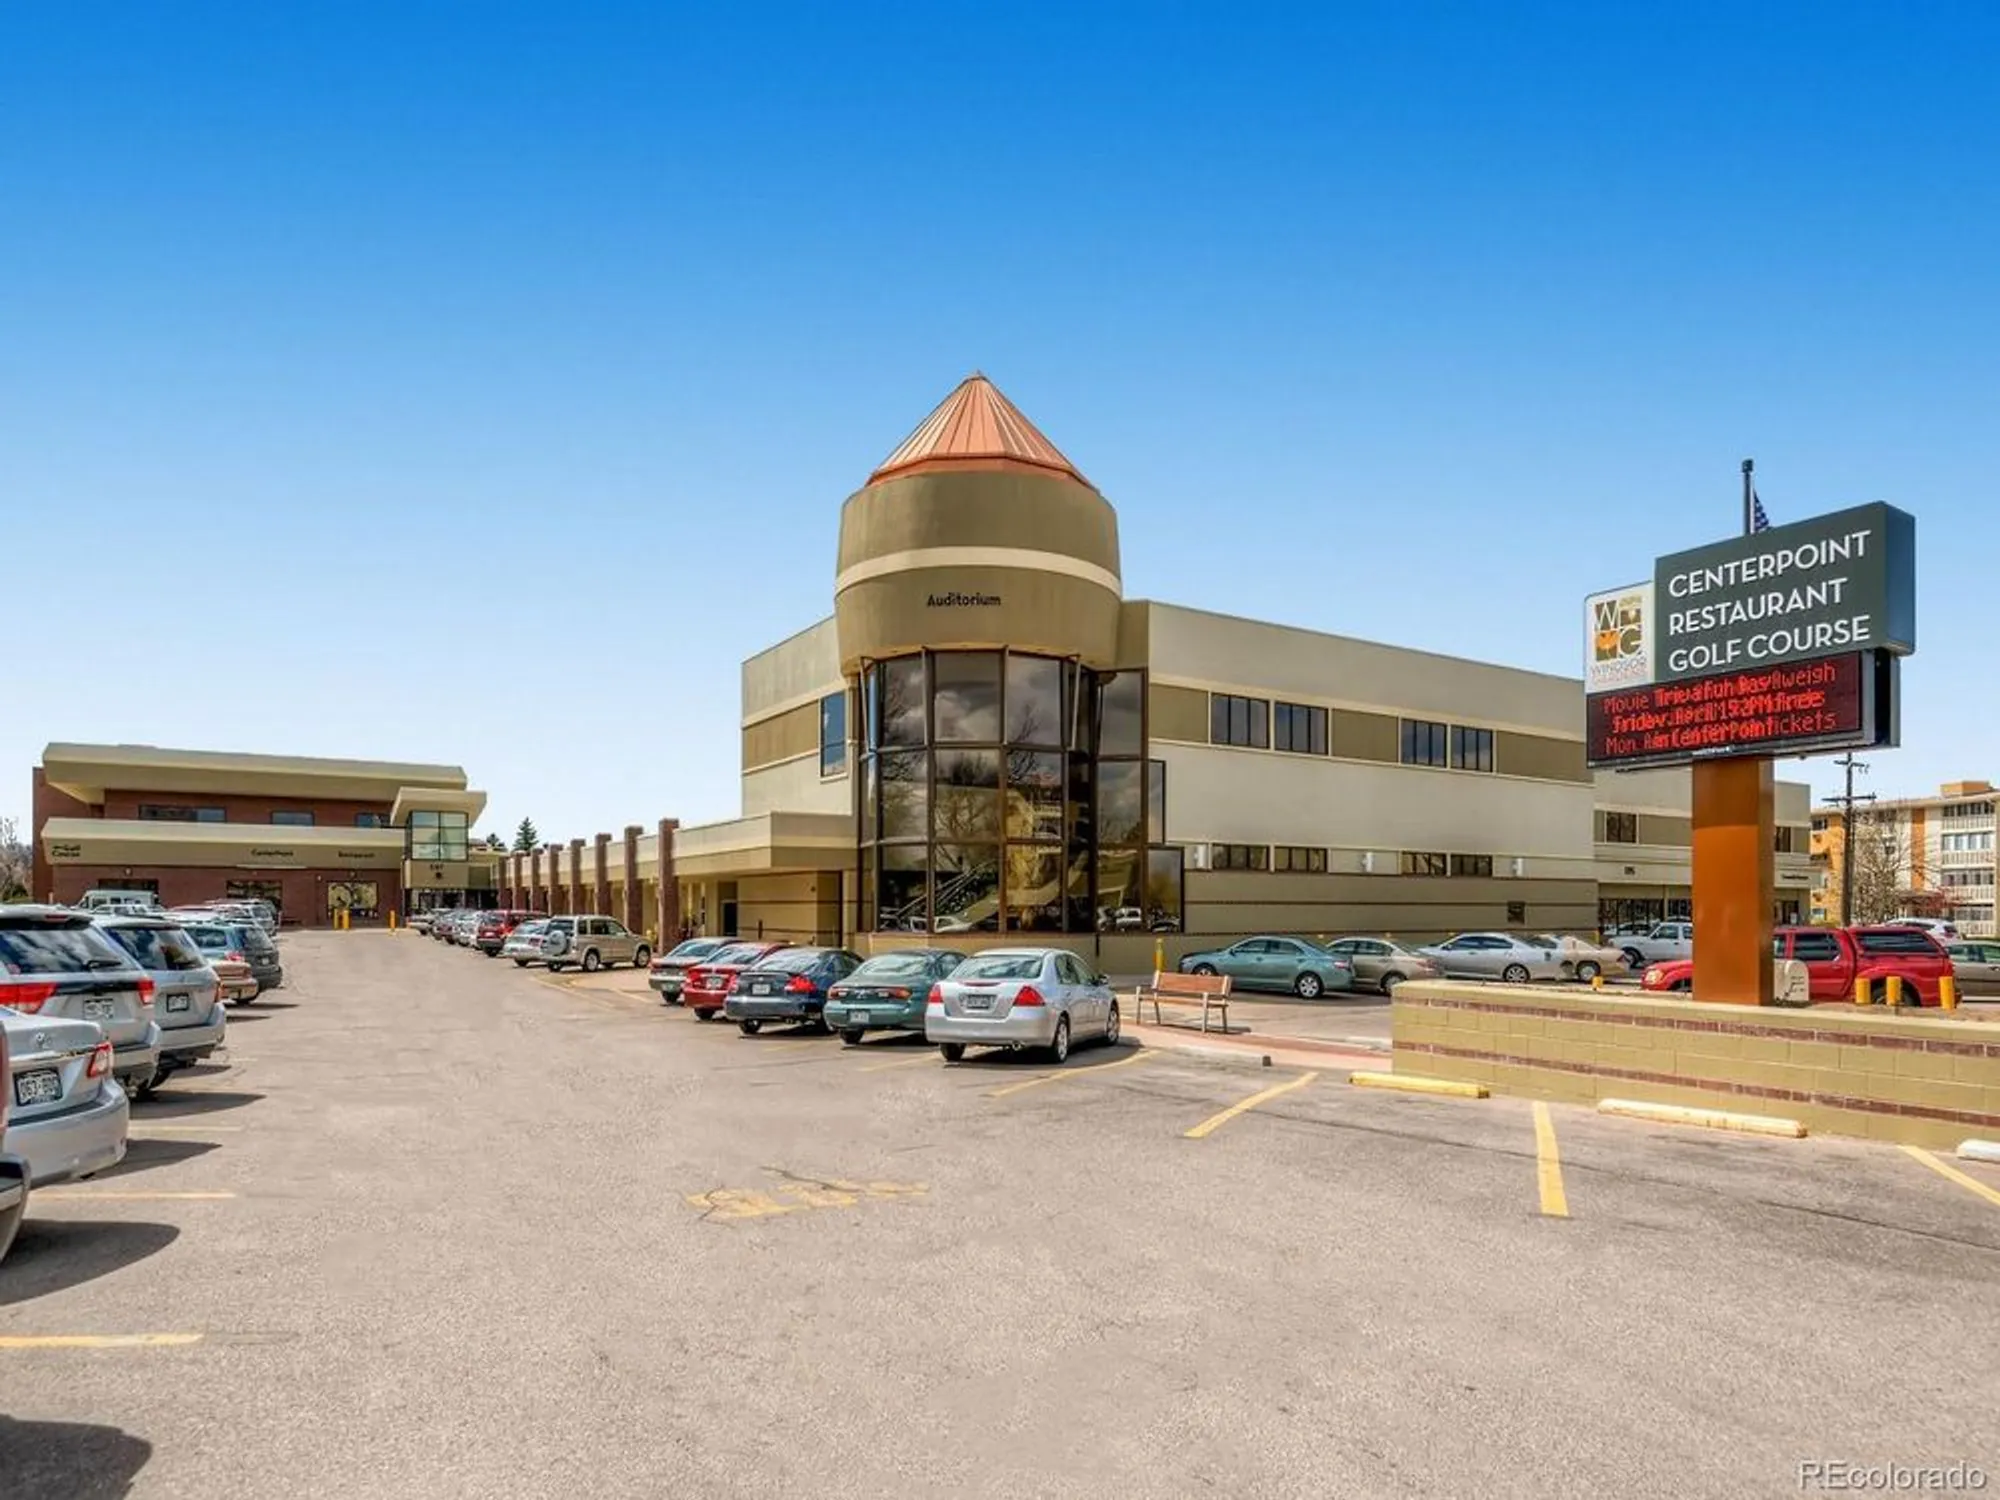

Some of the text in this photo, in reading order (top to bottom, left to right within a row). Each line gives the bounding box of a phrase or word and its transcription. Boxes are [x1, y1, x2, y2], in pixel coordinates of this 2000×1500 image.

[1668, 530, 1871, 598] CENTERPOINT
[927, 592, 1002, 607] Auditorium
[1669, 577, 1848, 636] RESTAURANT
[1668, 614, 1871, 672] GOLF COURSE
